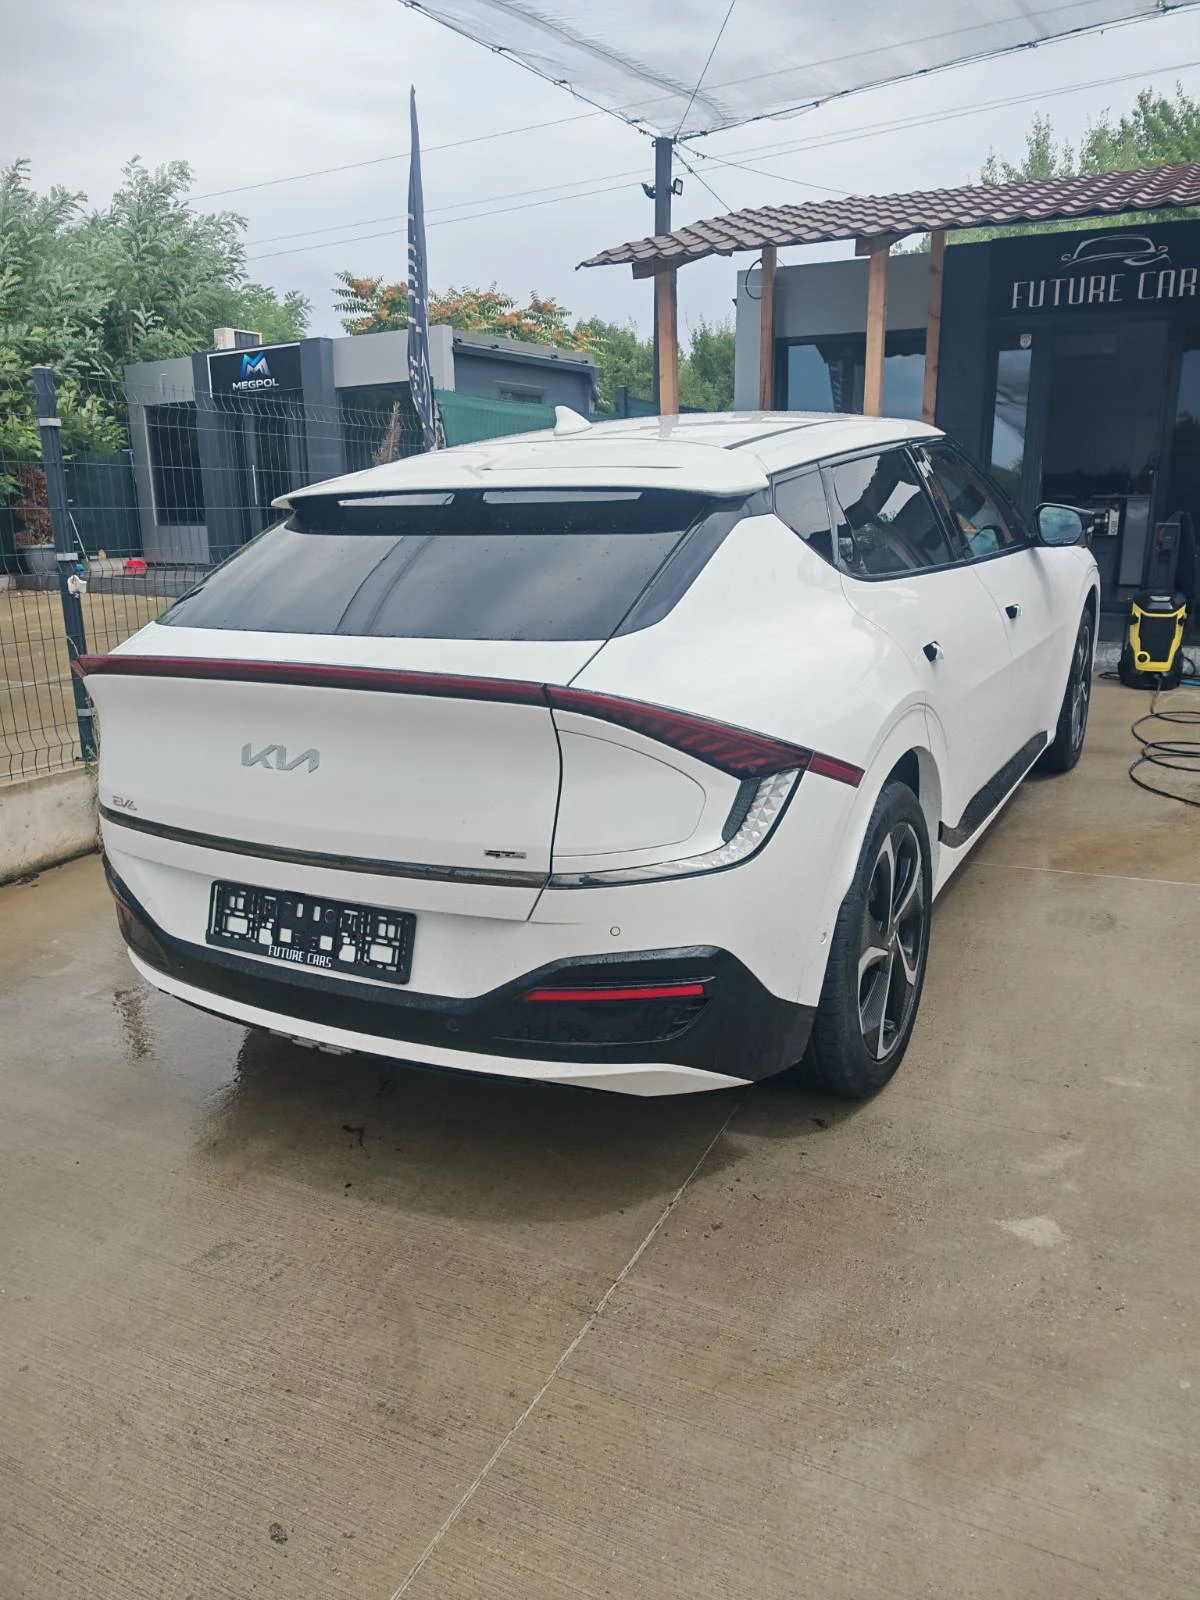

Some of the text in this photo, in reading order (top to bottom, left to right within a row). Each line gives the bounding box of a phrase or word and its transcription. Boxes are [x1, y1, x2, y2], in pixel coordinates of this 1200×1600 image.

[1012, 267, 1197, 309] FUTURE CAR
[232, 378, 279, 390] MEGPOL
[268, 945, 332, 968] FUTURE CARS
